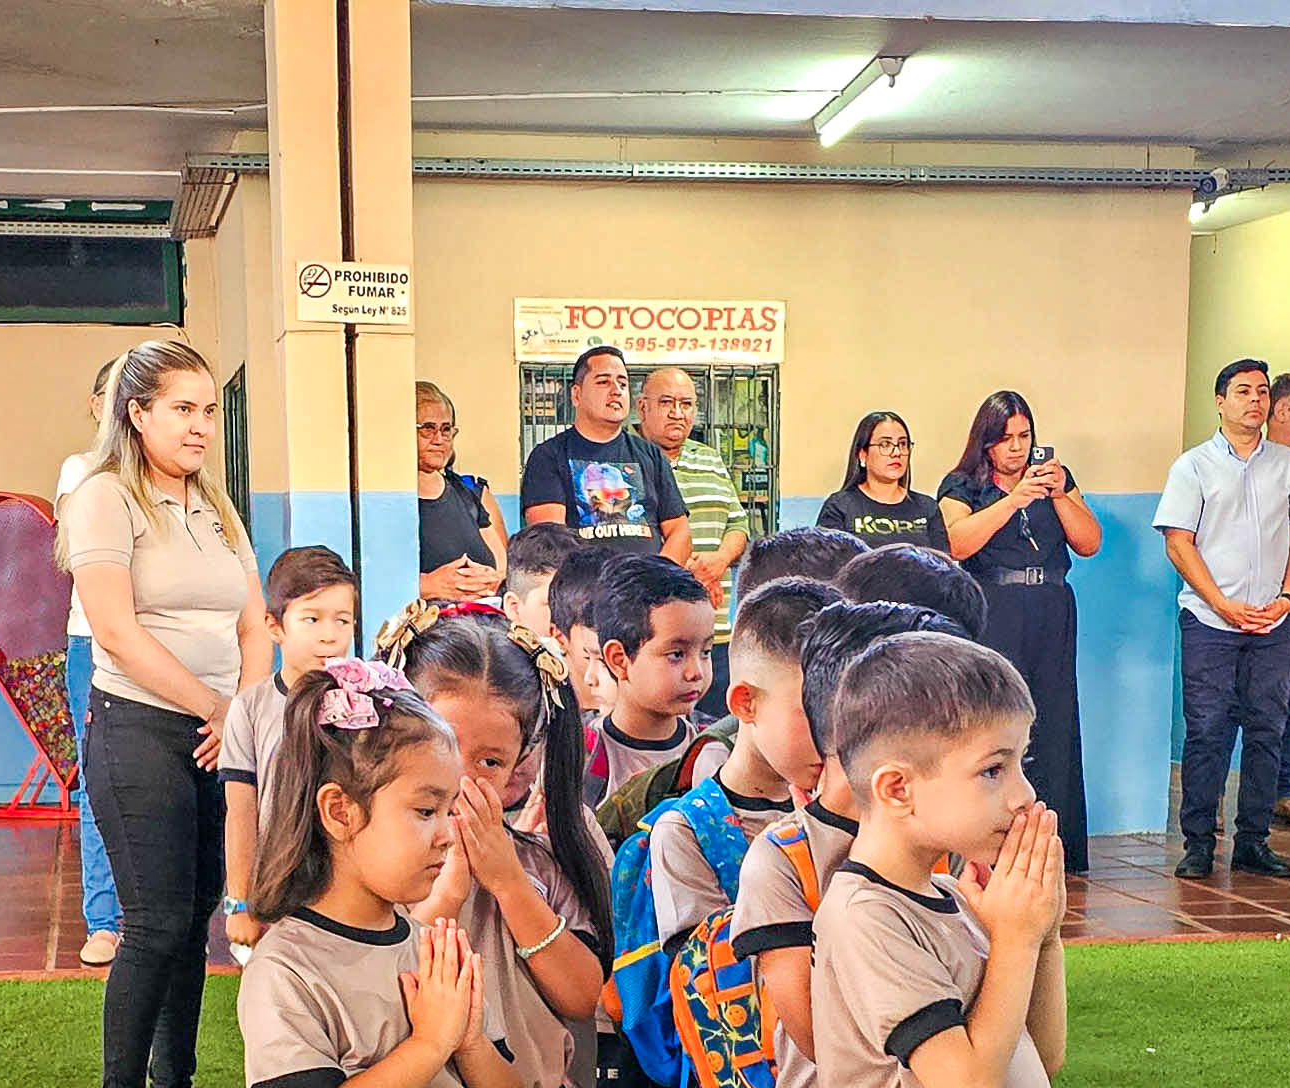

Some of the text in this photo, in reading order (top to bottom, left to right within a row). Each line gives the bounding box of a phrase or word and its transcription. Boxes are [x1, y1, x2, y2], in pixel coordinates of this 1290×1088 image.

[334, 270, 409, 285] PROHIBIDO
[348, 285, 395, 298] FUMAR
[362, 304, 377, 317] Ley
[565, 305, 777, 332] FOTOCOPIAS
[595, 524, 618, 538] OUT
[596, 1067, 619, 1079] IE
